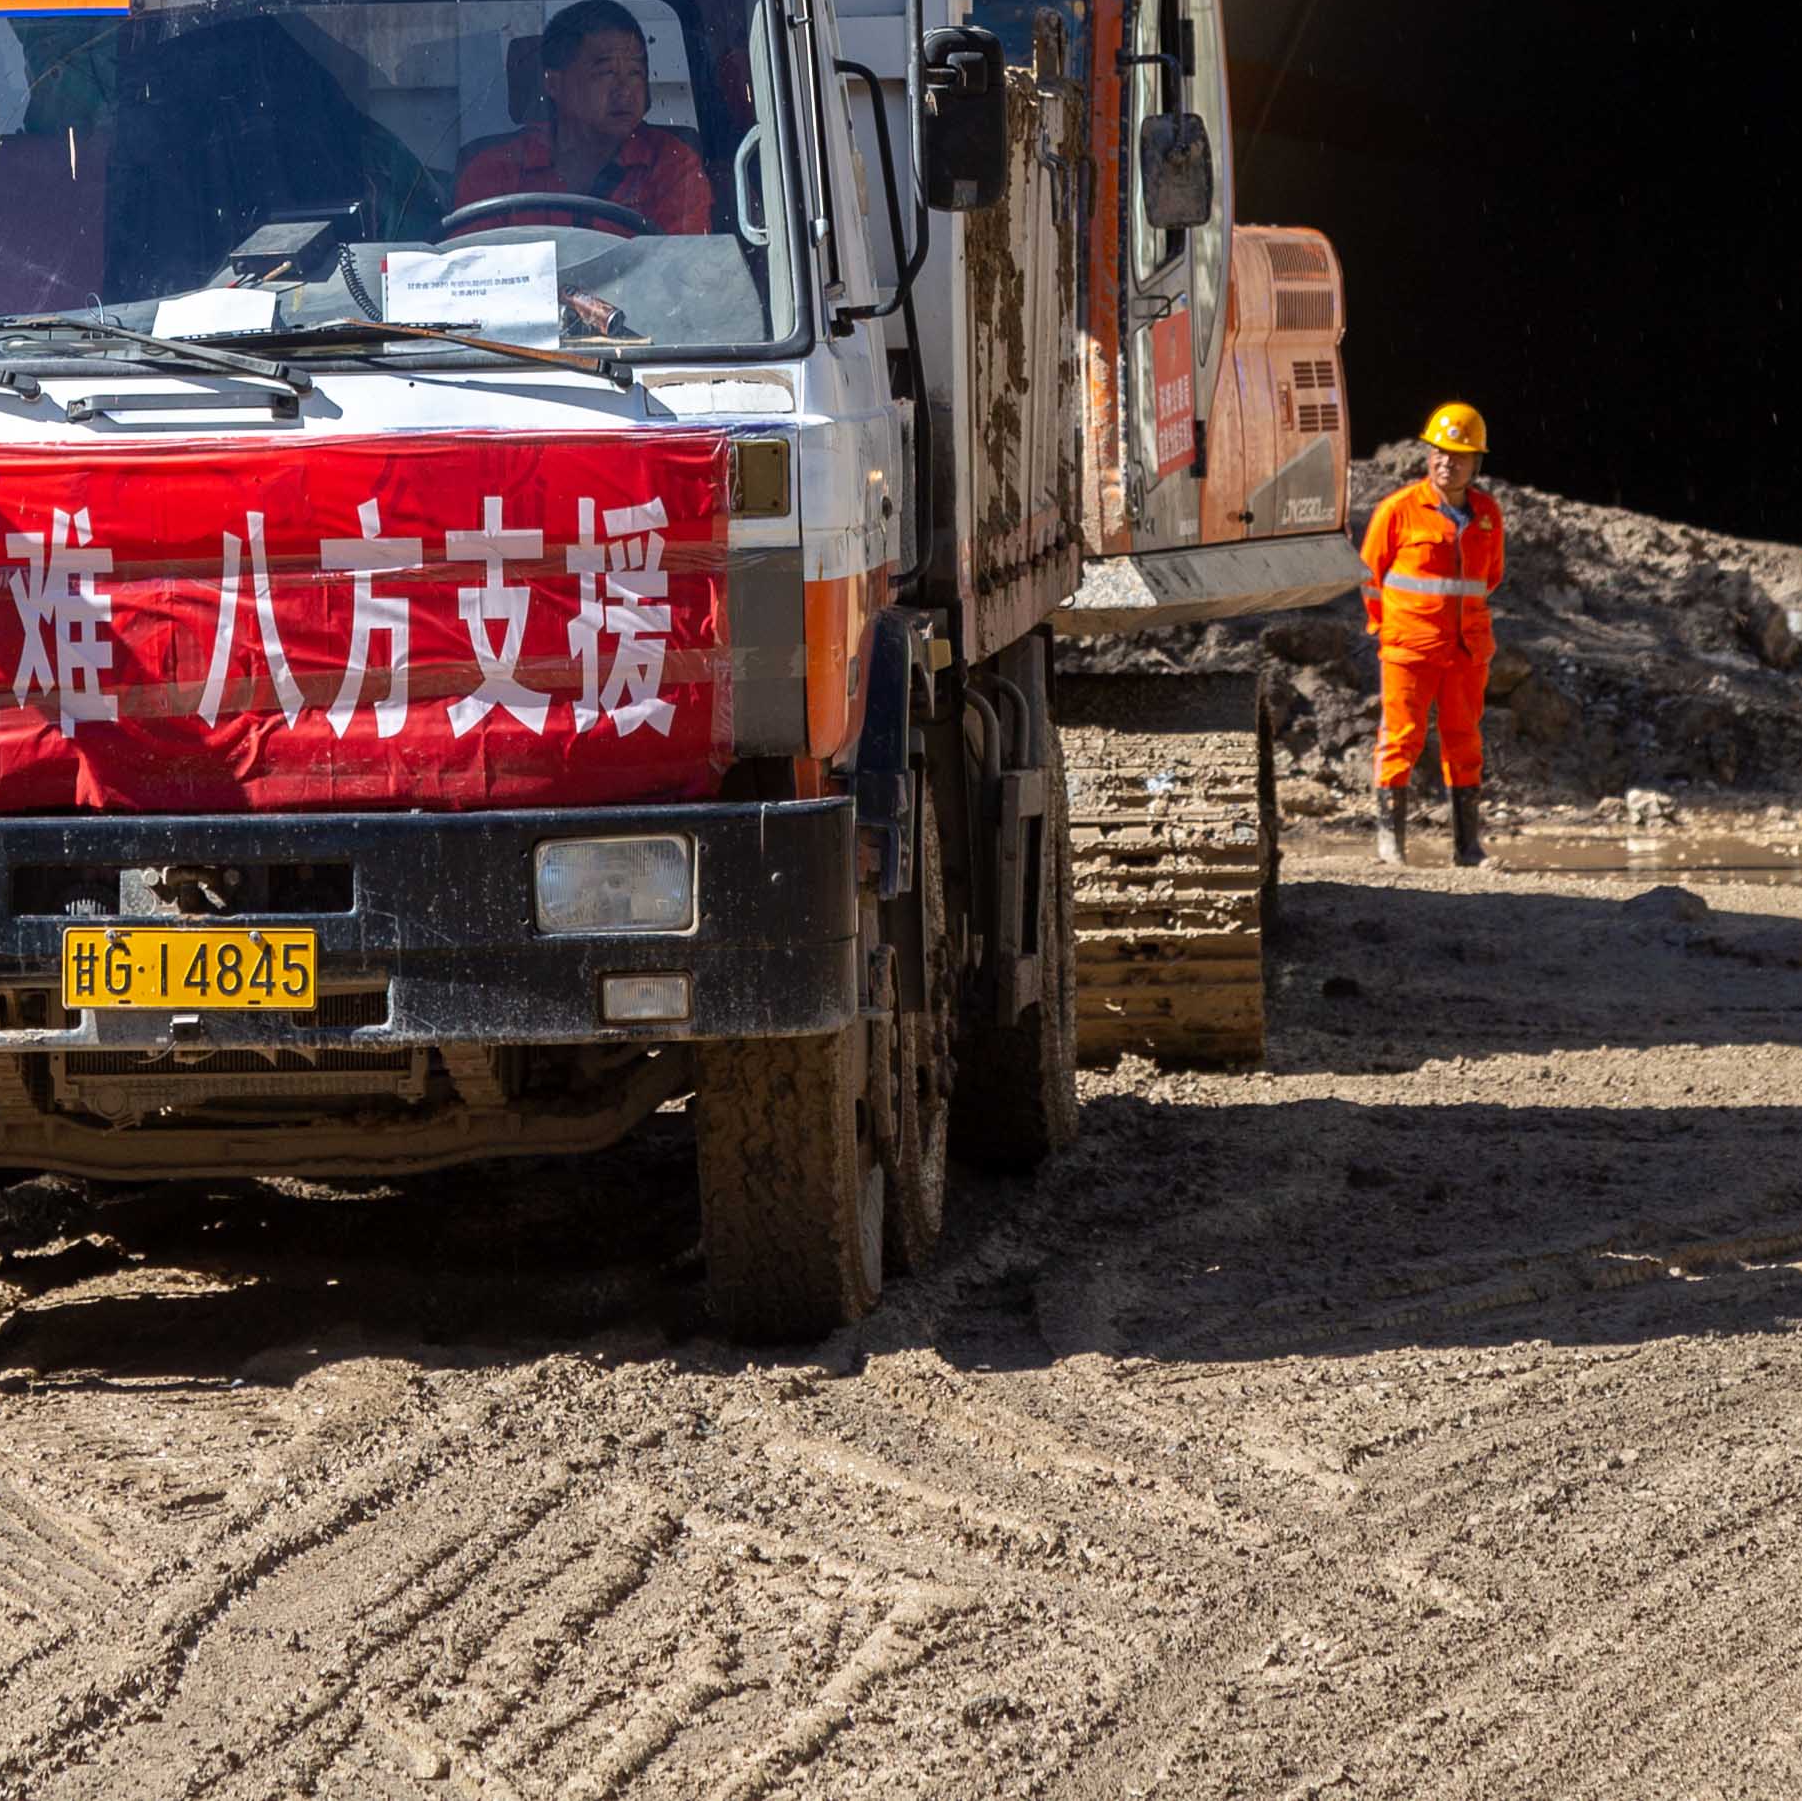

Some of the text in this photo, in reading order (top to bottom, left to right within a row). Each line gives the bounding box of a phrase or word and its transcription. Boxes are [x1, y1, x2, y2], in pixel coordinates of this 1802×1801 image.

[196, 495, 676, 740] 八方支援
[72, 942, 310, 998] 甘G·14845
